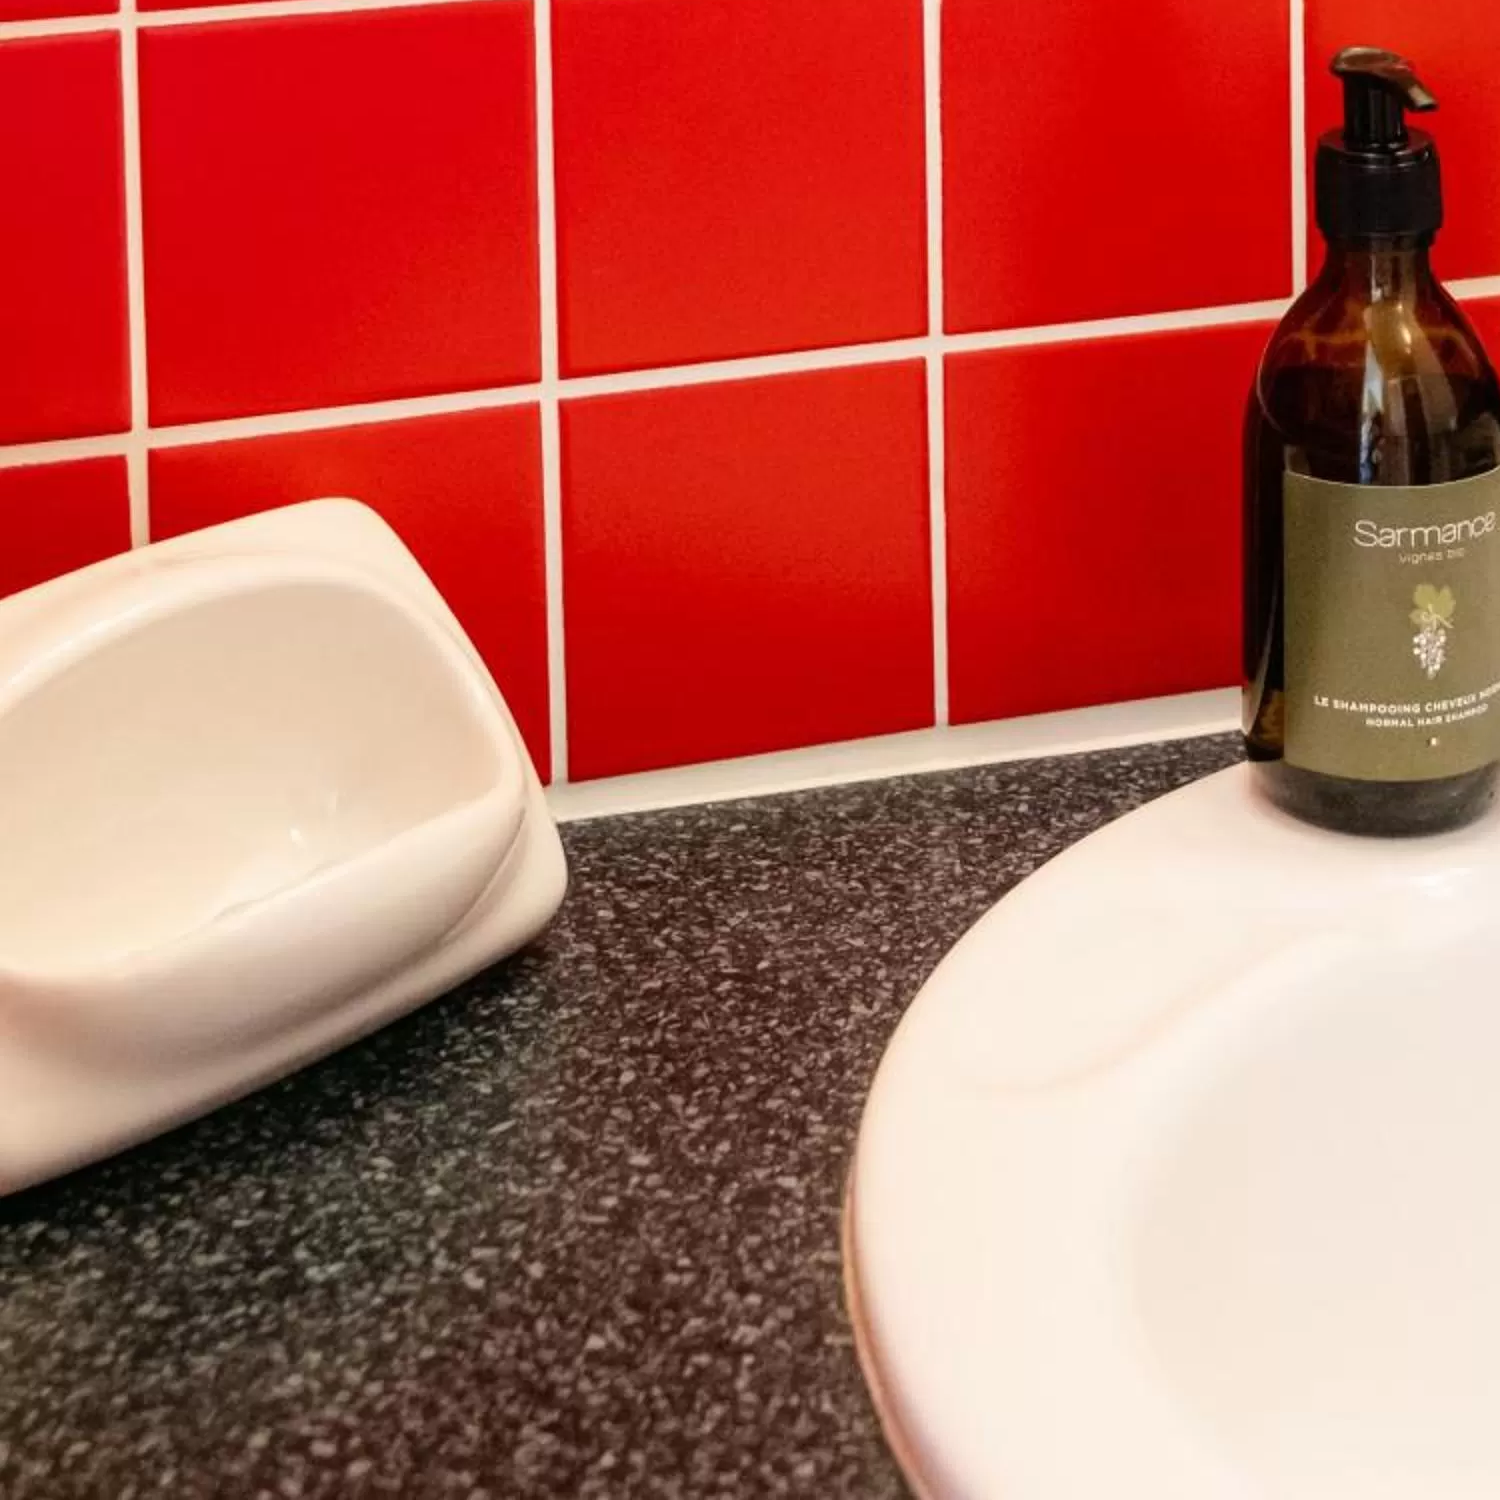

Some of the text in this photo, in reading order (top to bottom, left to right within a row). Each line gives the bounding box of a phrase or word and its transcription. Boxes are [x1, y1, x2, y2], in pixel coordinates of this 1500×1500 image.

[1354, 511, 1497, 548] Sarmance
[1398, 550, 1443, 565] vignes
[1314, 695, 1330, 708] LE
[1333, 700, 1421, 714] SHAMPOOING
[1424, 693, 1478, 714] CHEVEUX
[1364, 703, 1488, 729] NORMAL HAIR SHAMPOO
